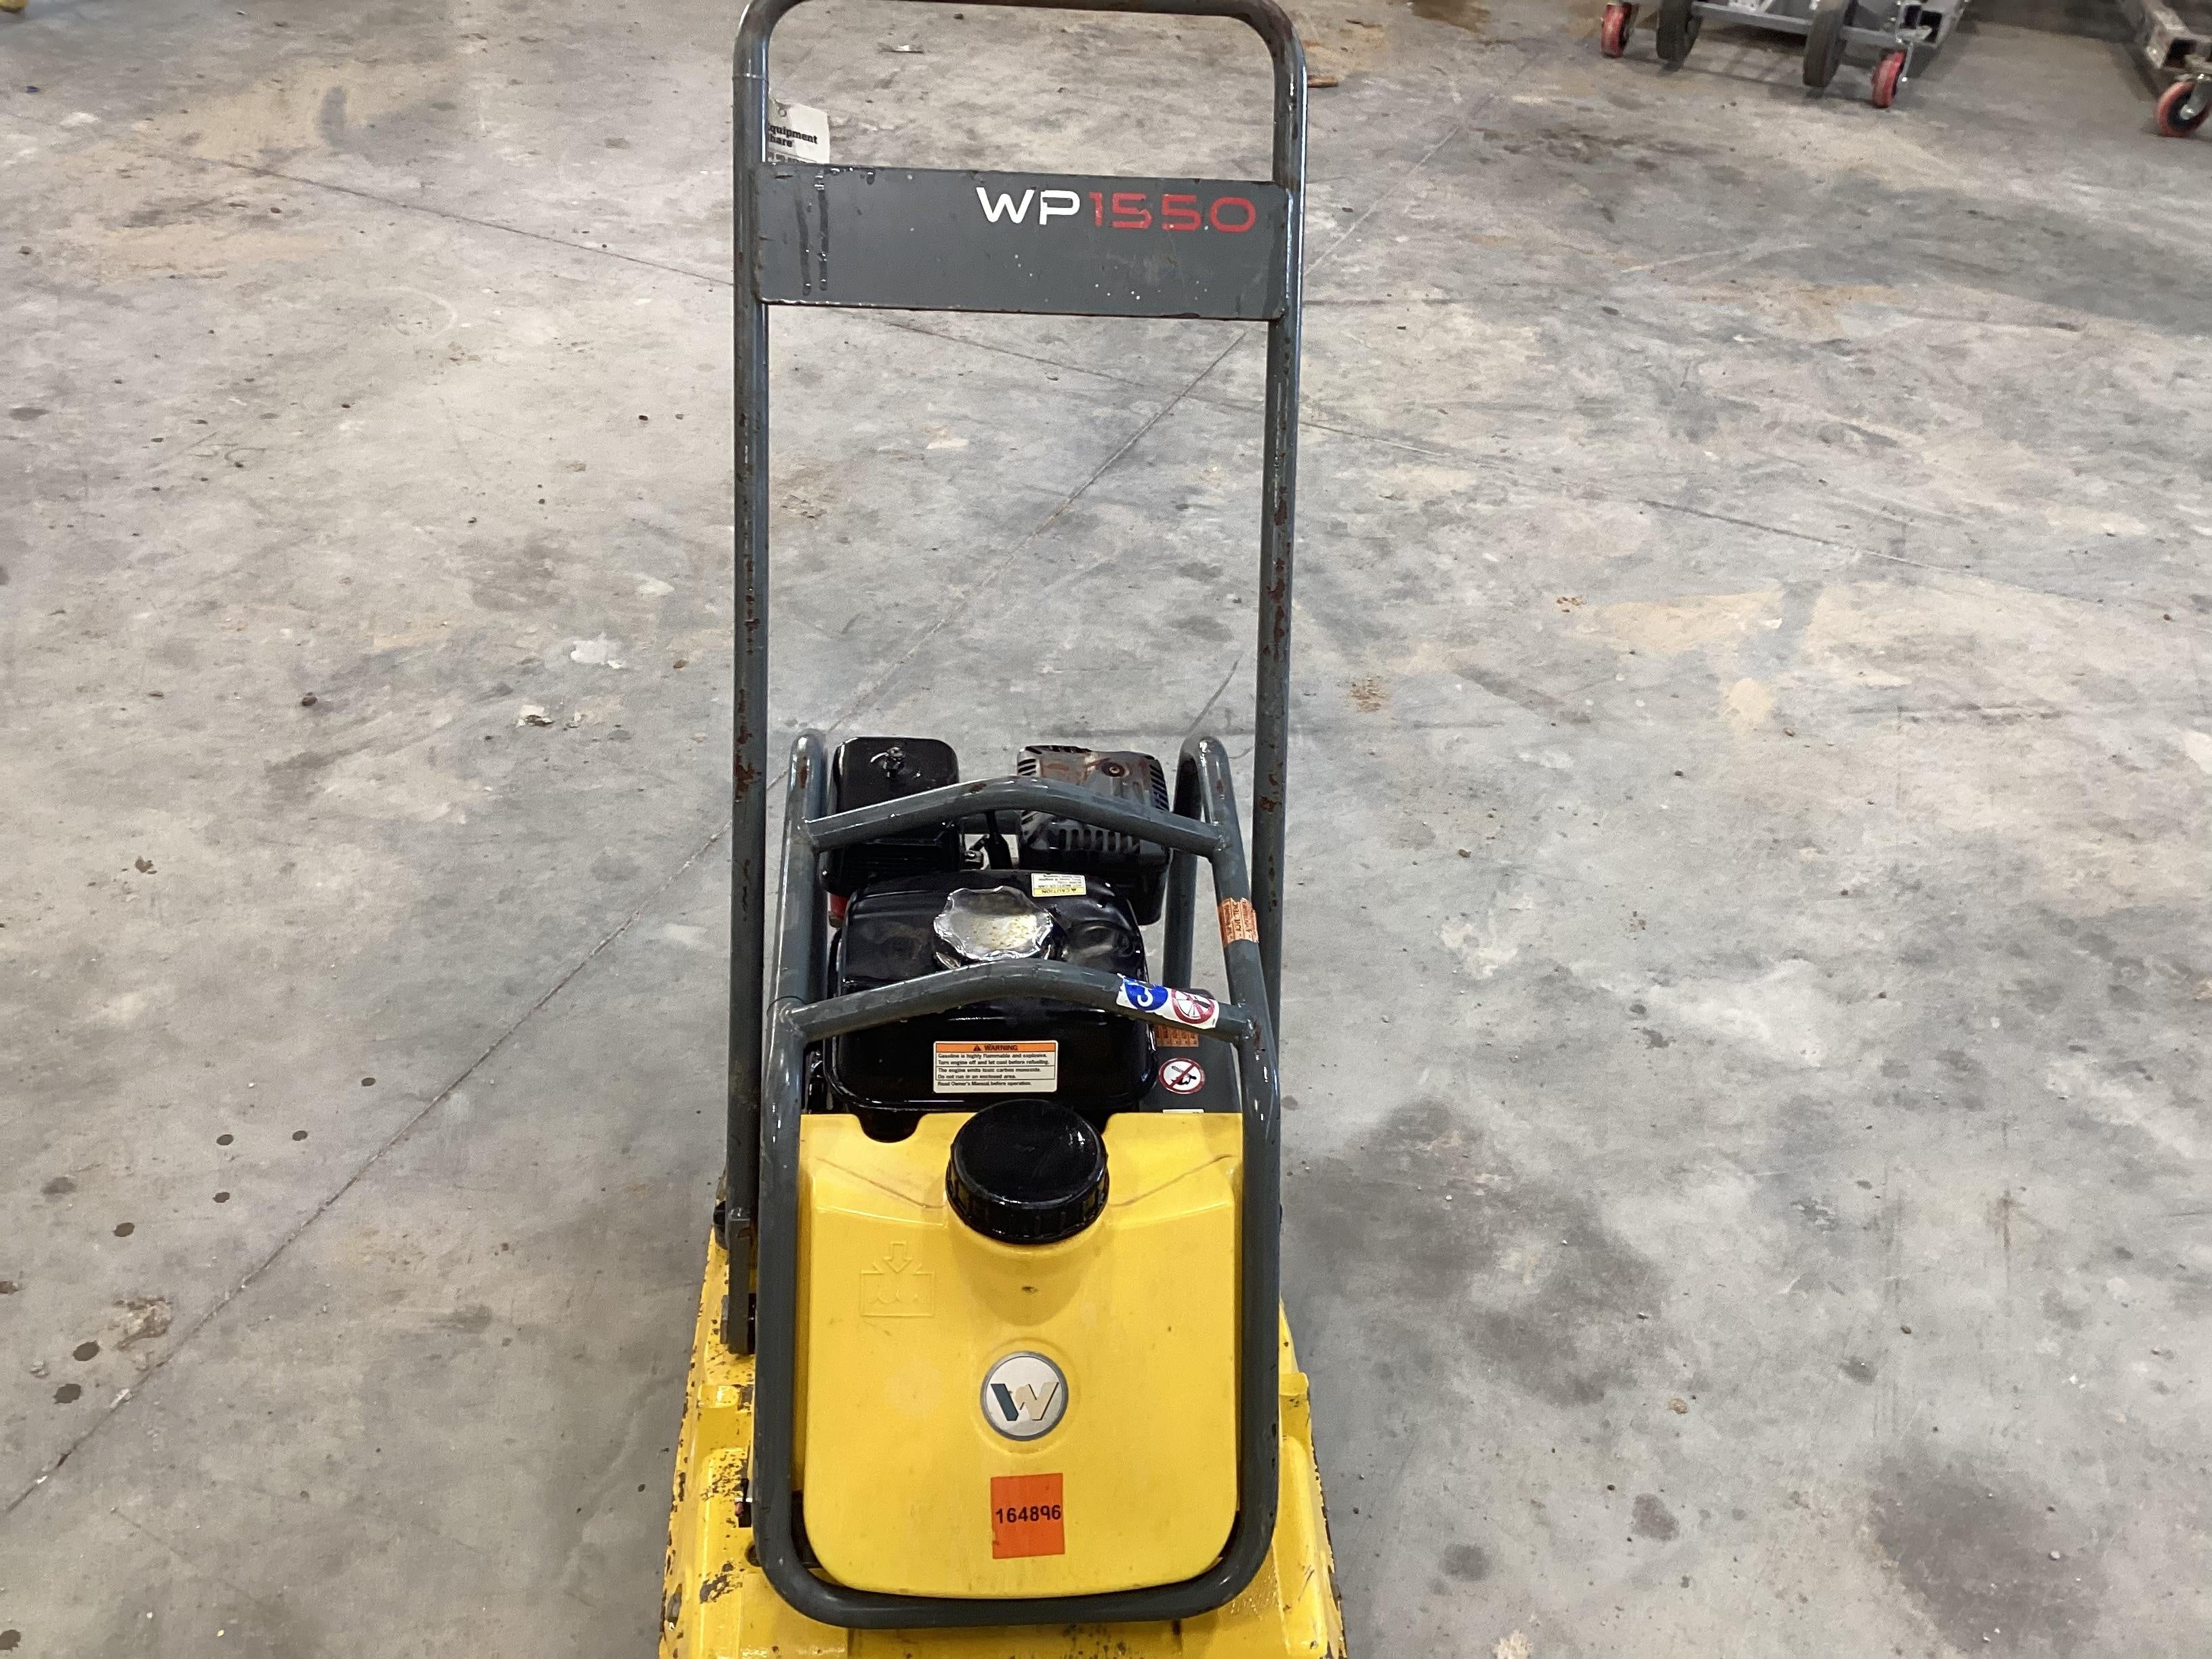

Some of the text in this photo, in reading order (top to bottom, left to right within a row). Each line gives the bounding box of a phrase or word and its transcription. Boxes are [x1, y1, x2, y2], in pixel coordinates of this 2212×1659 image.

[769, 125, 817, 144] quipment
[769, 134, 792, 147] hare
[996, 1504, 1061, 1523] 164896
